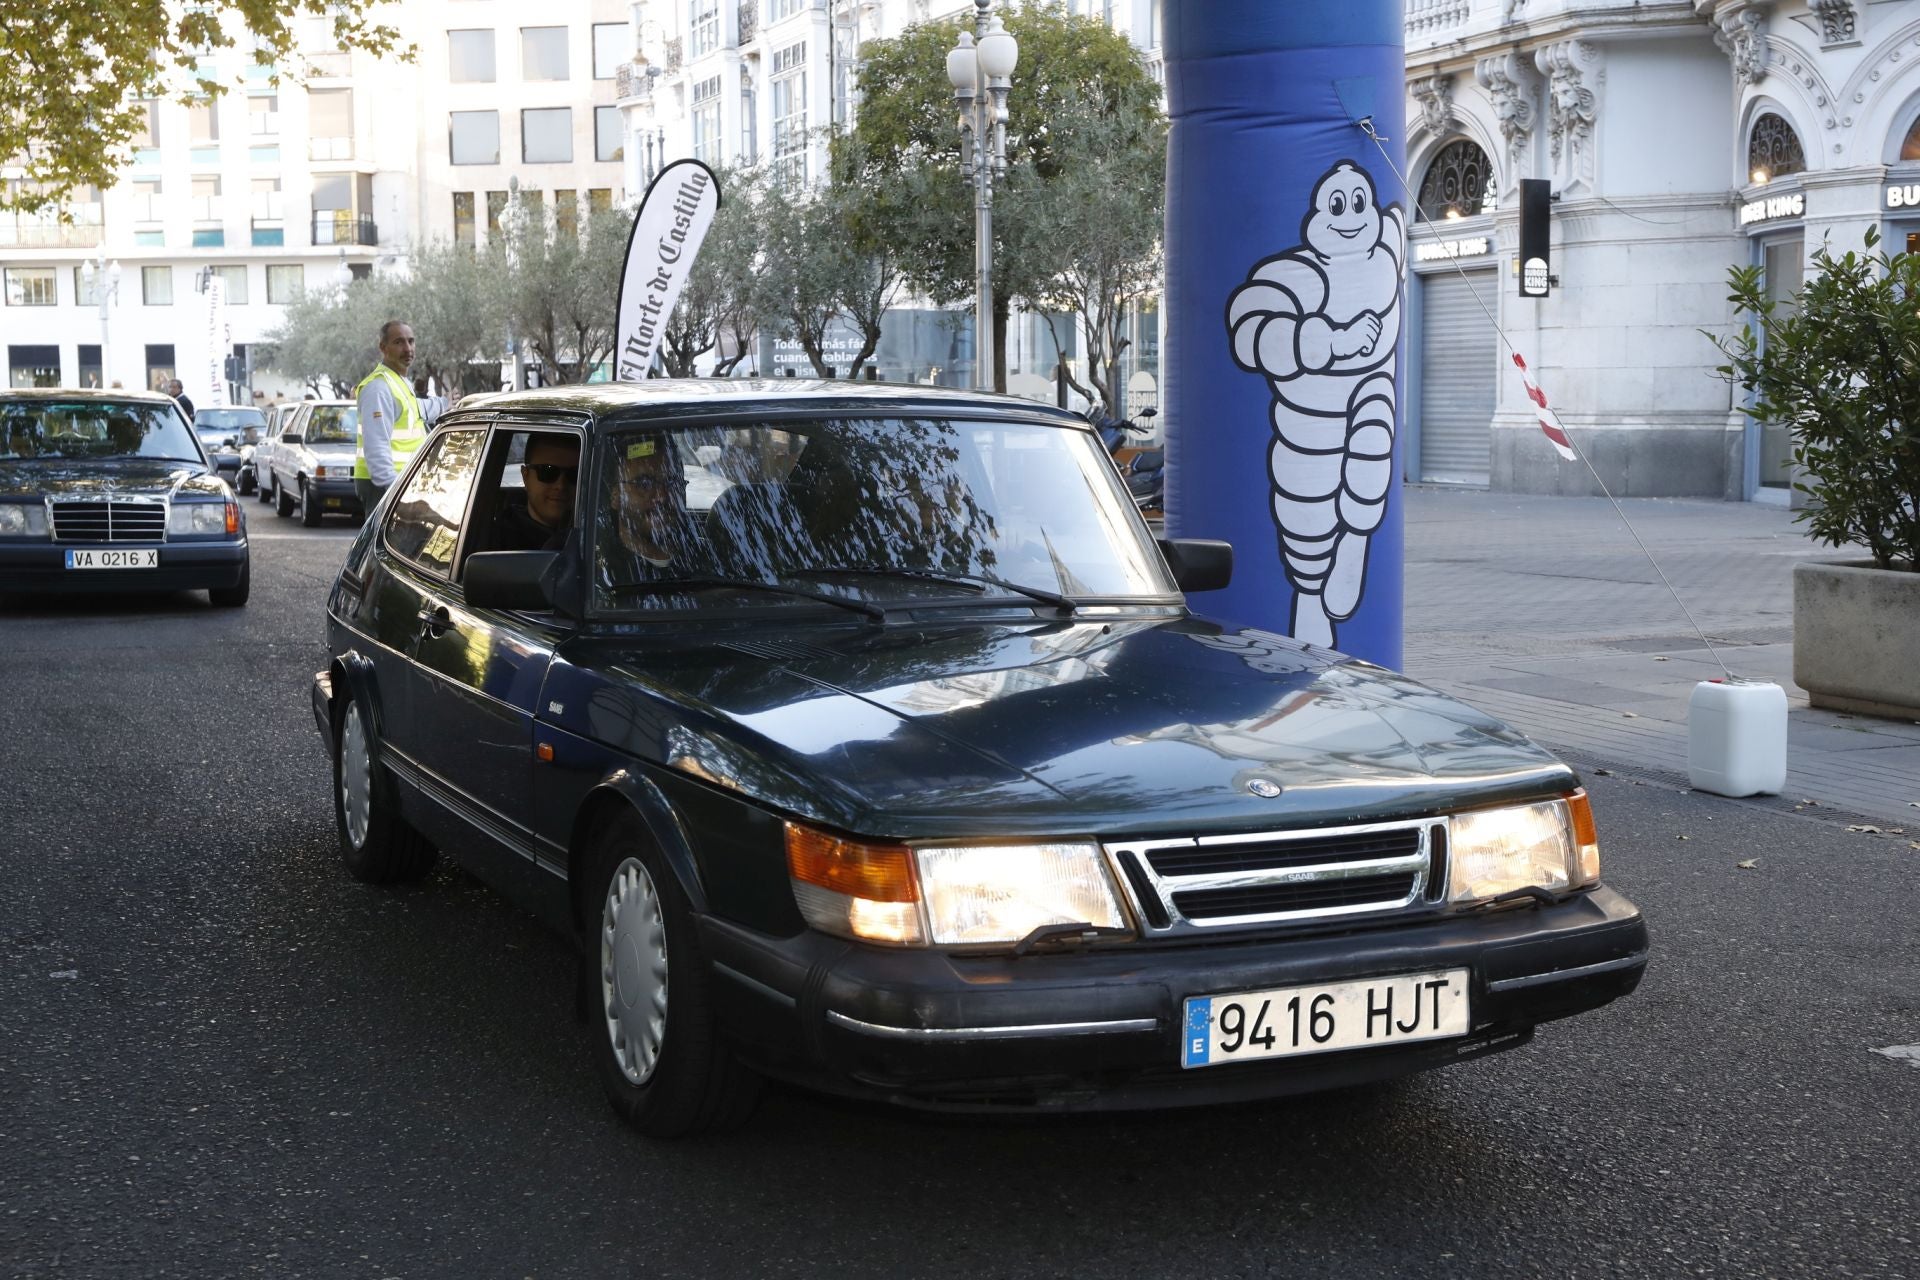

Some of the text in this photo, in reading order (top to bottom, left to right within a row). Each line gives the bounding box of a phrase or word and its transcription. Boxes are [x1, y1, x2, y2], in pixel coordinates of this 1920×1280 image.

[1767, 194, 1803, 218] KING
[658, 172, 709, 265] Castilla
[1459, 237, 1487, 256] KING
[646, 266, 672, 292] de
[1524, 268, 1548, 277] BURGER
[1524, 277, 1548, 288] KING
[625, 294, 663, 358] Norte
[821, 338, 846, 349] más
[773, 353, 810, 363] cuand
[774, 365, 786, 377] el
[74, 552, 93, 566] VA
[102, 552, 138, 566] 0216
[147, 552, 156, 566] X
[1287, 872, 1316, 881] SAAB
[1192, 980, 1449, 1053] E 9416 HJT
